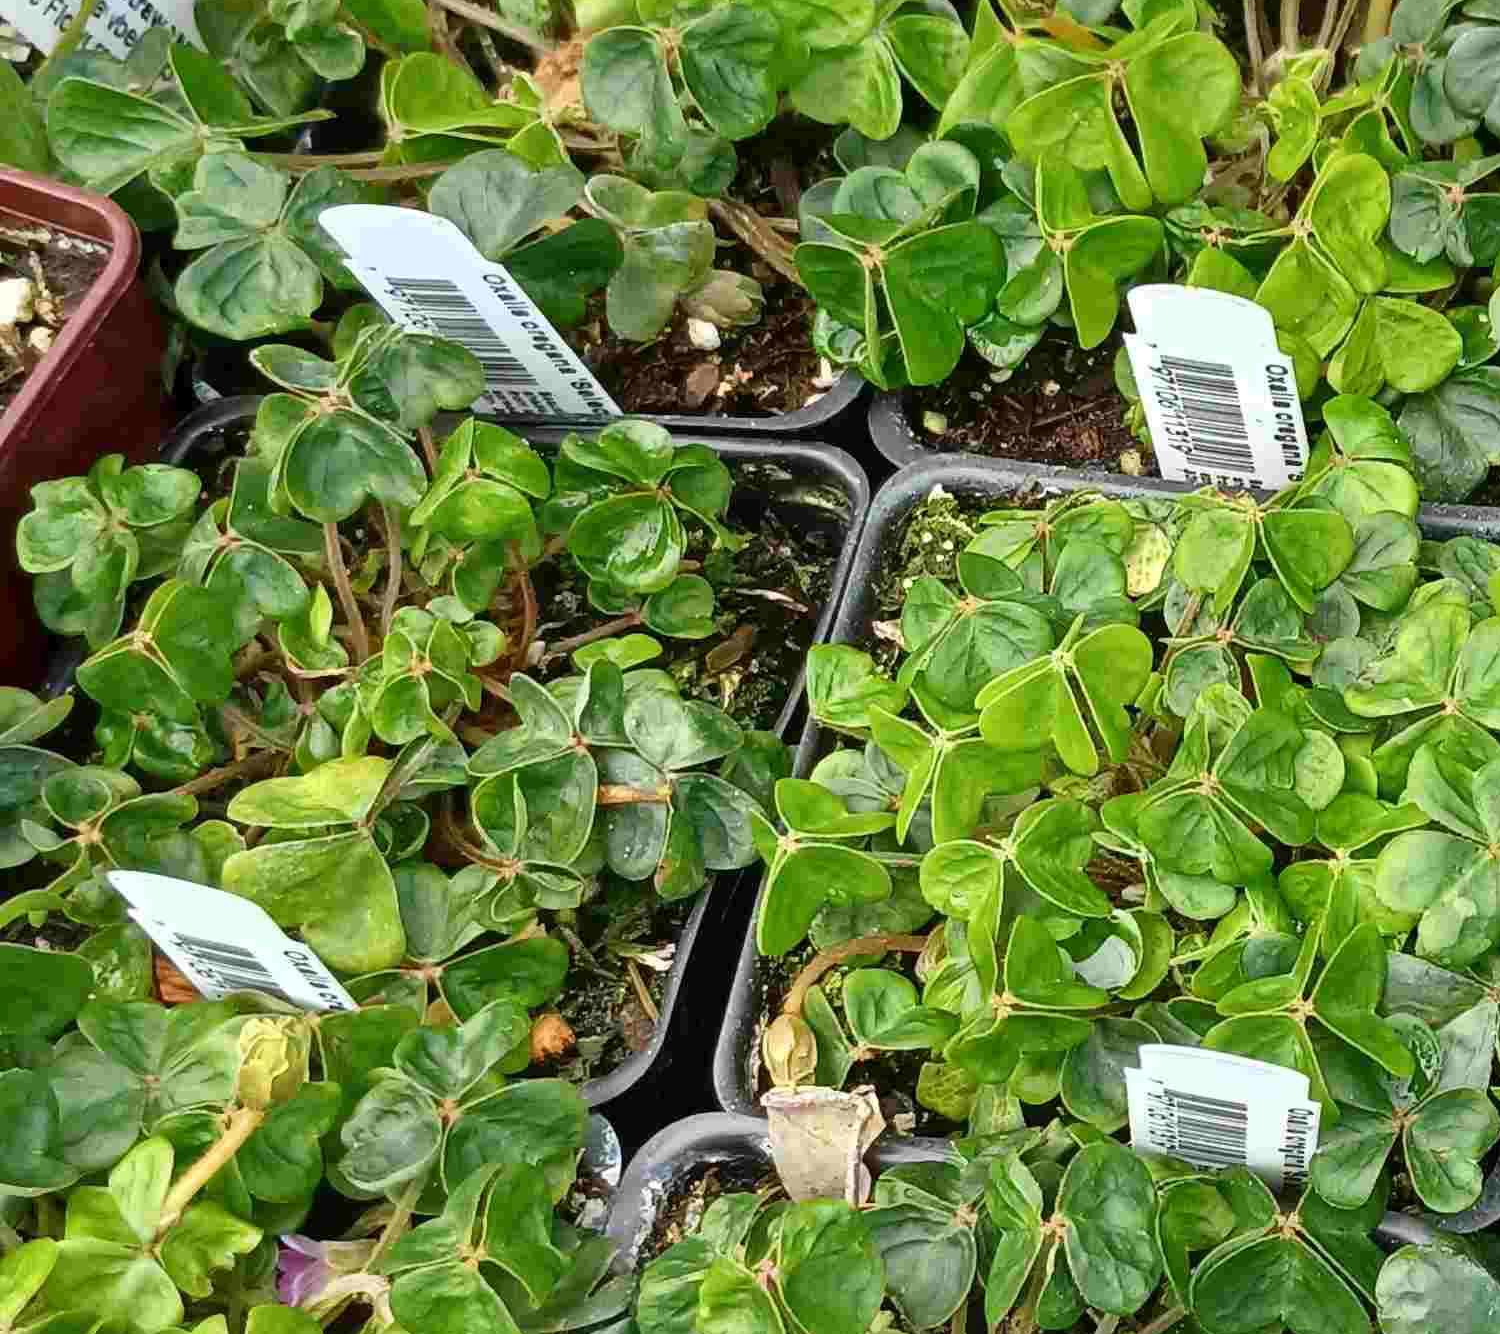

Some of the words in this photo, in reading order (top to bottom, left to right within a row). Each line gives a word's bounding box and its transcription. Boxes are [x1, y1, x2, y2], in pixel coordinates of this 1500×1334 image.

[483, 274, 529, 317] Oxalis
[521, 321, 577, 374] oregana
[1265, 364, 1294, 408] Oxalis
[1274, 412, 1303, 467] oregana
